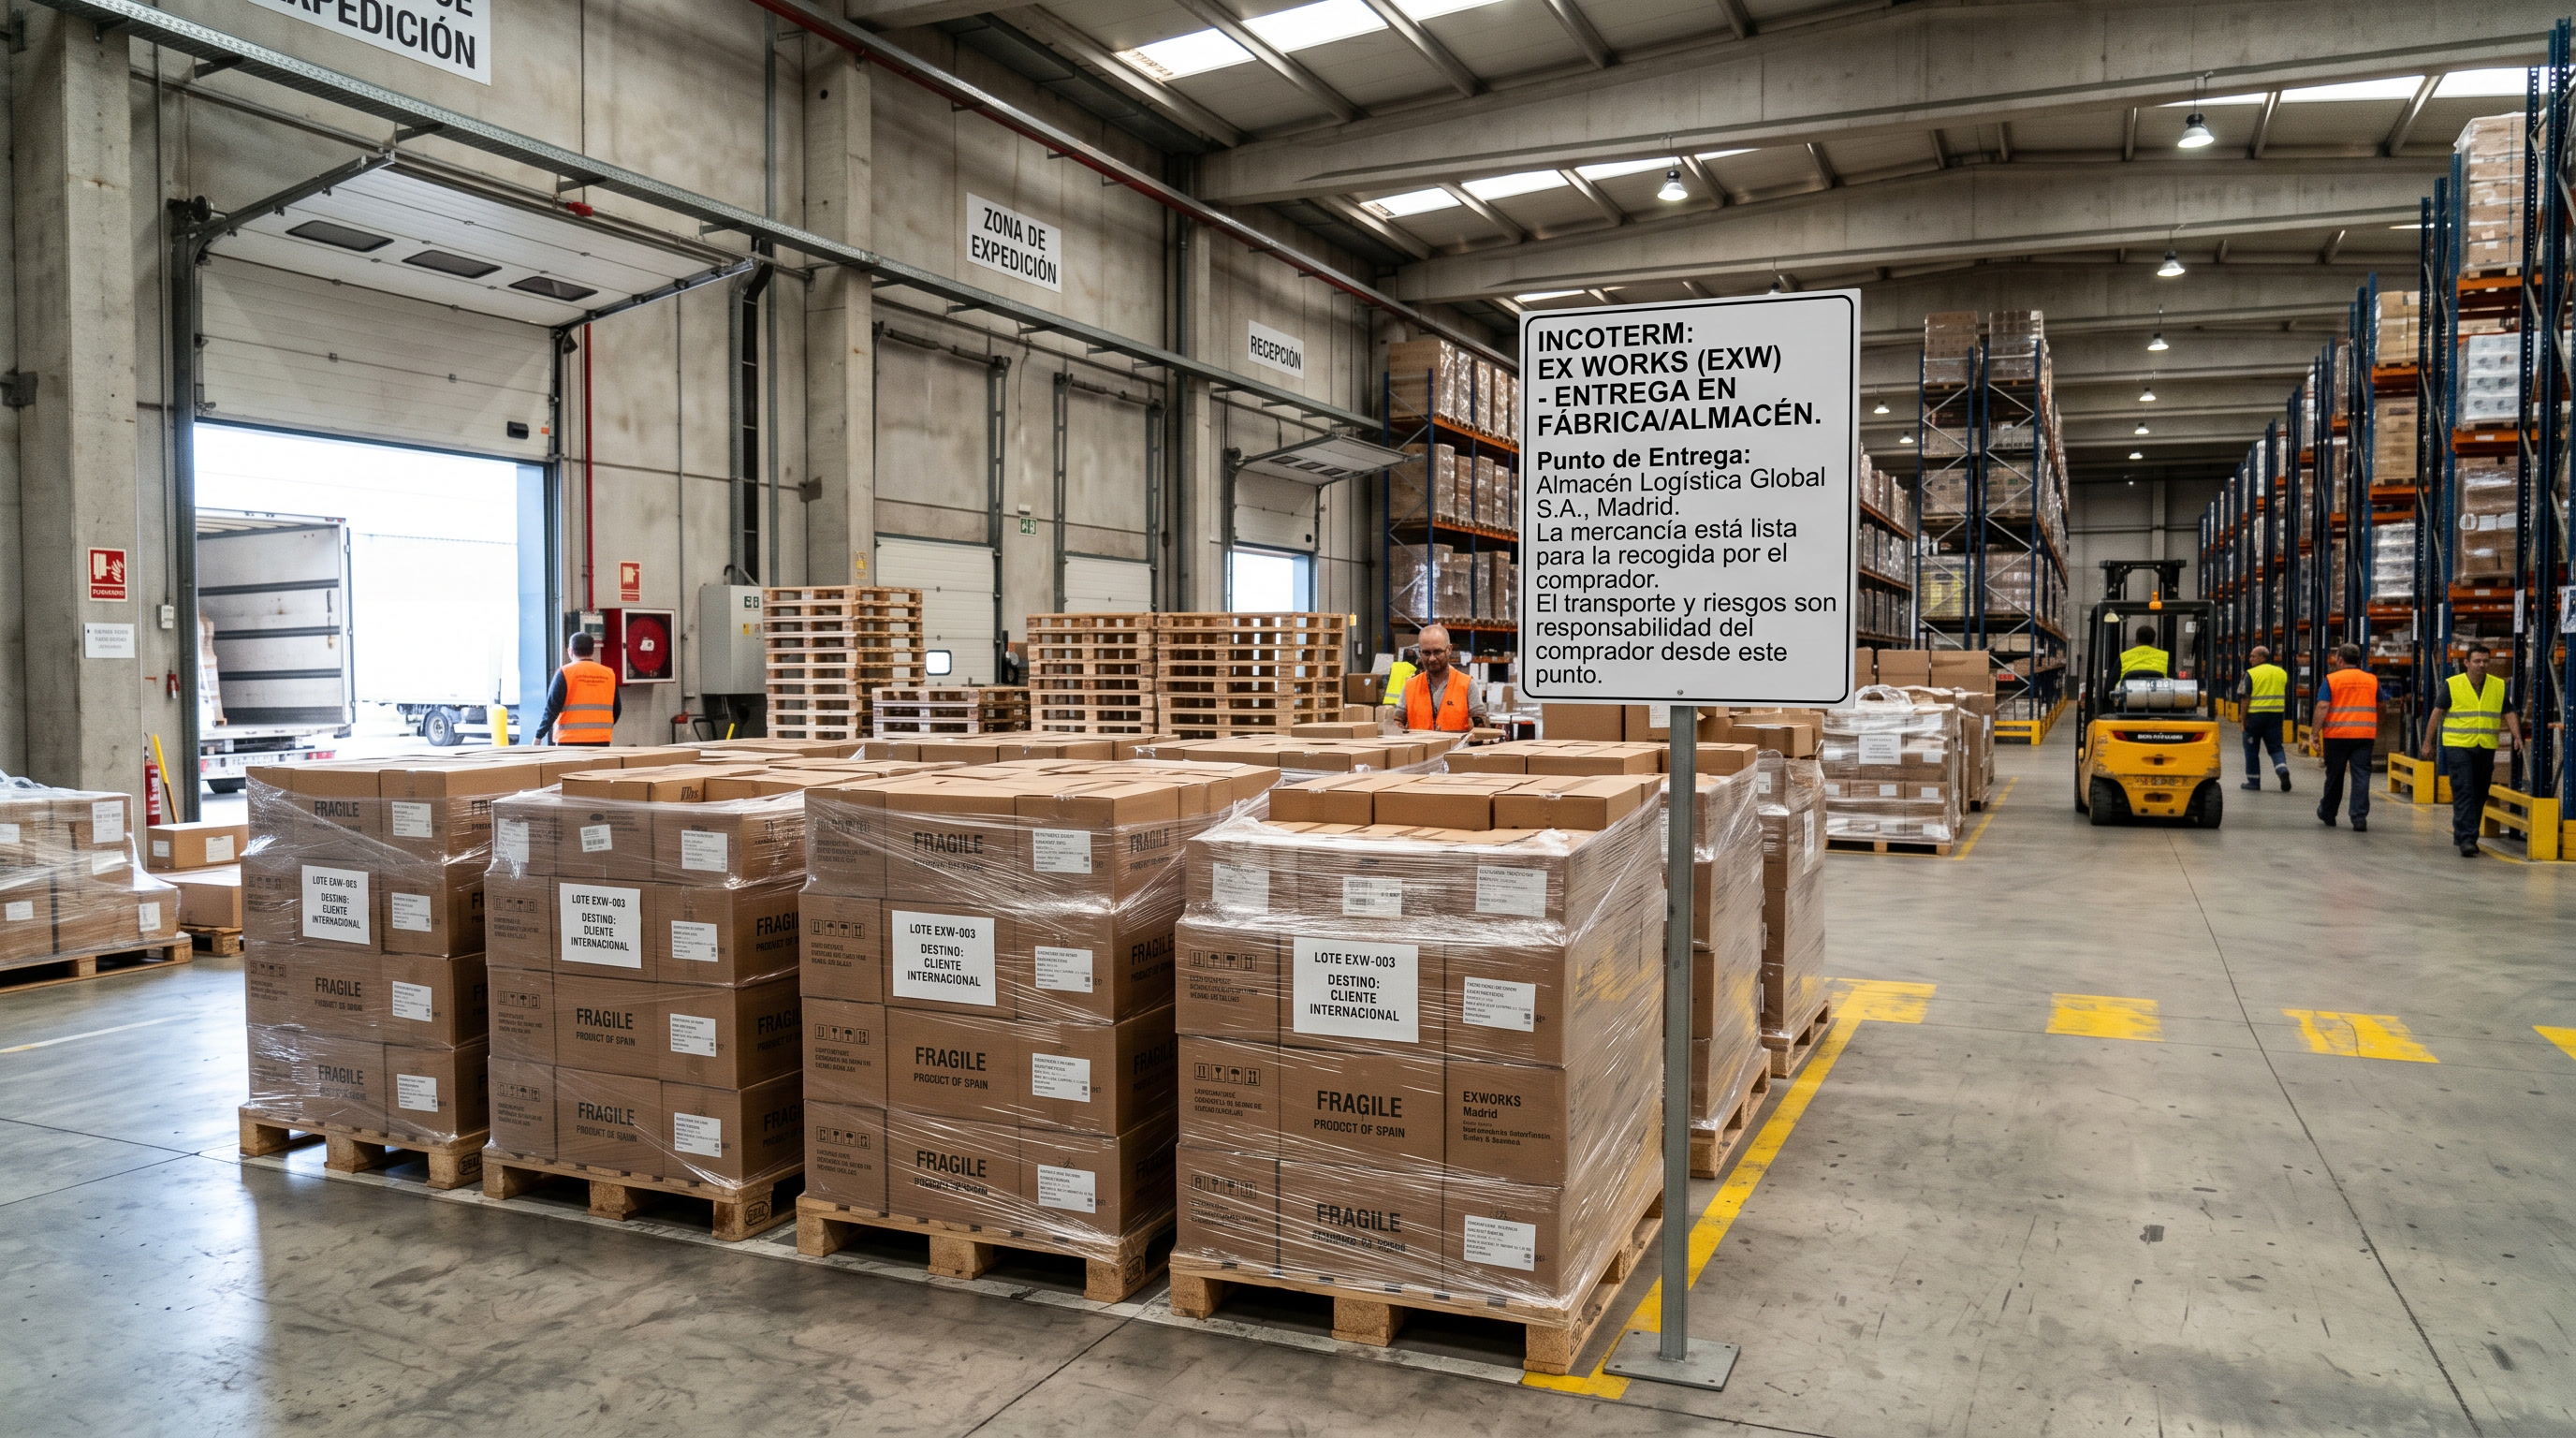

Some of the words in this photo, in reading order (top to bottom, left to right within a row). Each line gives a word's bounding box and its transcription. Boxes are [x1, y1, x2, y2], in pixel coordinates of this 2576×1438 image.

[281, 0, 476, 69] EDICIÓN
[984, 207, 1023, 243] ZONA
[1028, 225, 1046, 251] DE
[972, 234, 1057, 285] EXPEDICIÓN
[1538, 322, 1693, 353] INCOTERM:
[1251, 334, 1301, 370] RECEPCIÓN
[1538, 358, 1573, 380] EX
[1581, 351, 1689, 378] WORKS
[1697, 345, 1781, 377] (EXW)
[1555, 380, 1690, 408] ENTREGA
[1698, 376, 1736, 401] EN
[1538, 398, 1822, 437] FÁBRICA/ALMACÉN.
[1537, 451, 1605, 471] Punto
[1613, 448, 1641, 469] de
[1649, 448, 1750, 470] Entrega:
[1536, 474, 1632, 495] Almacén
[1640, 470, 1742, 496] Logística
[1749, 466, 1825, 489] Global
[1537, 498, 1588, 521] S.A.,
[1597, 496, 1679, 518] Madrid.
[1537, 523, 1563, 542] La
[1571, 520, 1687, 542] mercancía
[1694, 519, 1743, 539] está
[1751, 519, 1797, 538] lista
[1536, 550, 1585, 571] para
[1593, 545, 1611, 565] la
[1618, 544, 1715, 569] recogida
[1723, 548, 1762, 568] por
[1767, 543, 1787, 563] el
[1536, 569, 1659, 594] comprador.
[1537, 593, 1557, 613] El
[1564, 594, 1676, 618] transporte
[1683, 597, 1696, 618] y
[1704, 592, 1787, 618] riesgos
[1794, 596, 1837, 612] son
[1536, 617, 1711, 641] responsabilidad
[1719, 618, 1753, 638] del
[1536, 641, 1655, 665] comprador
[1661, 641, 1731, 661] desde
[1738, 642, 1788, 662] este
[1536, 665, 1603, 688] punto.
[315, 800, 359, 817] FRAGILE
[914, 832, 983, 854] FRAGILE
[313, 875, 328, 886] LOTE
[572, 894, 590, 905] LOTE
[592, 896, 626, 908] EXW-003
[756, 911, 799, 936] FRAGI
[910, 923, 932, 935] LOTE
[934, 925, 976, 939] EXW-003
[571, 936, 630, 952] INTERNACIONAL
[920, 943, 964, 957] DESTINO:
[1132, 932, 1174, 966] FRAGILE
[924, 958, 961, 971] CLIENTE
[1314, 951, 1342, 964] LOTE
[1345, 953, 1396, 968] EXW-003
[315, 976, 361, 998] FRAGILE
[907, 970, 981, 987] INTERNACIONAL
[1327, 974, 1380, 989] DESTINO:
[1330, 990, 1377, 1005] CLIENTE
[577, 1007, 634, 1030] FRAGILE
[758, 1007, 802, 1035] FRAGIL
[1310, 1003, 1400, 1022] INTERNACIONAL
[915, 1046, 987, 1072] FRAGILE
[318, 1064, 364, 1086] FRAGILE
[952, 1077, 962, 1087] OF
[964, 1078, 988, 1090] SPAIN
[1317, 1090, 1402, 1119] FRAGILE
[1463, 1091, 1521, 1108] EXWORKS
[578, 1101, 635, 1126] FRAGILE
[764, 1105, 804, 1132] FRAGI
[1463, 1106, 1498, 1119] Madrid
[1360, 1123, 1373, 1136] OF
[1375, 1125, 1405, 1138] SPAIN
[916, 1150, 987, 1179] FRAGILE
[1316, 1202, 1402, 1233] FRAGILE
